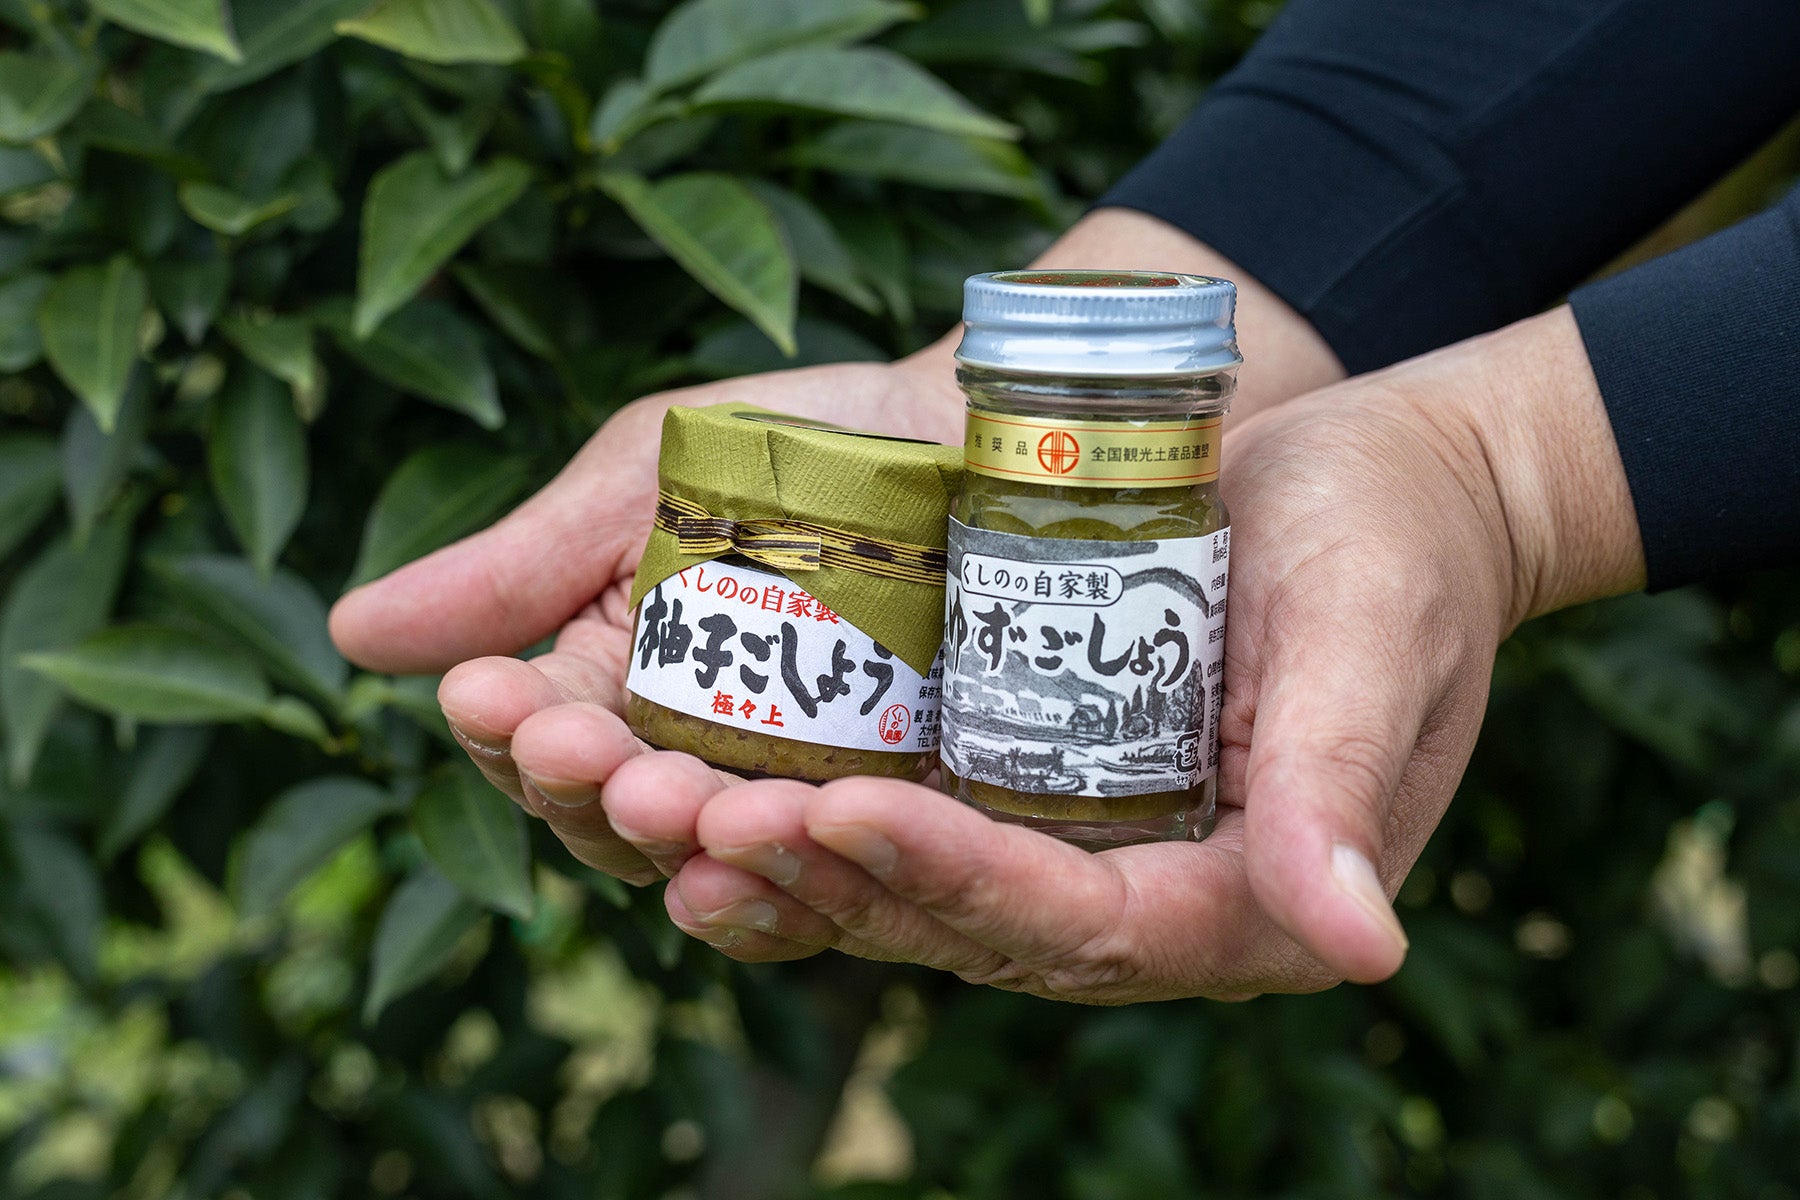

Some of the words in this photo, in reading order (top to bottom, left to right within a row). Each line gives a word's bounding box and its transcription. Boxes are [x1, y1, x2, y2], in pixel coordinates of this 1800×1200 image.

[1091, 442, 1210, 463] 全国観光土産品連盟
[962, 560, 1111, 601] くしのの自家製
[638, 583, 895, 719] 柚子ごしょう
[711, 690, 785, 728] 極々上
